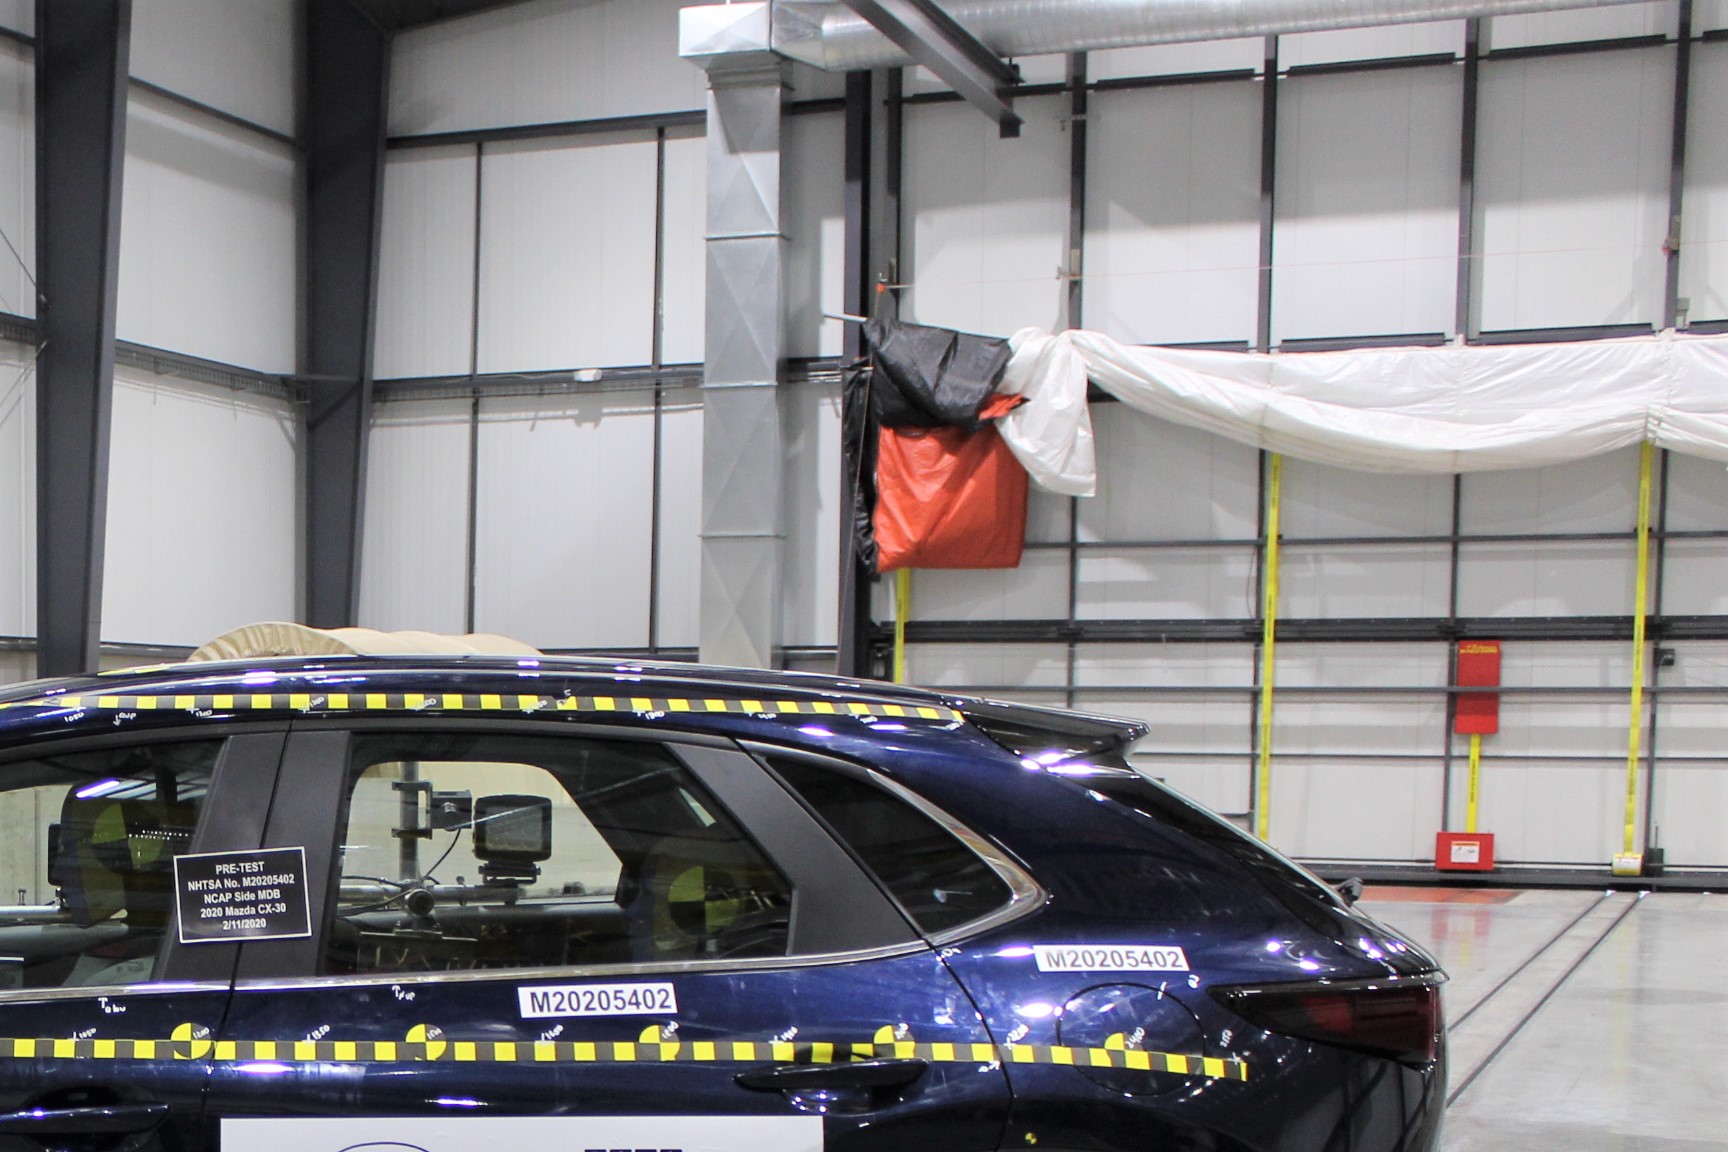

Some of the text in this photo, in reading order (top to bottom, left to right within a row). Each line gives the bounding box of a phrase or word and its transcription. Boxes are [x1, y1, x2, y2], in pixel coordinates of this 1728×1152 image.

[215, 862, 264, 875] PRE-TEST
[188, 874, 295, 891] NHTSA No. M20205402
[204, 889, 281, 904] NCAP Side MDB
[200, 903, 286, 918] 2020 Mazda CX-30
[222, 918, 266, 930] 2/11/2020
[1044, 949, 1183, 968] M20205402
[530, 988, 672, 1013] M20205402
